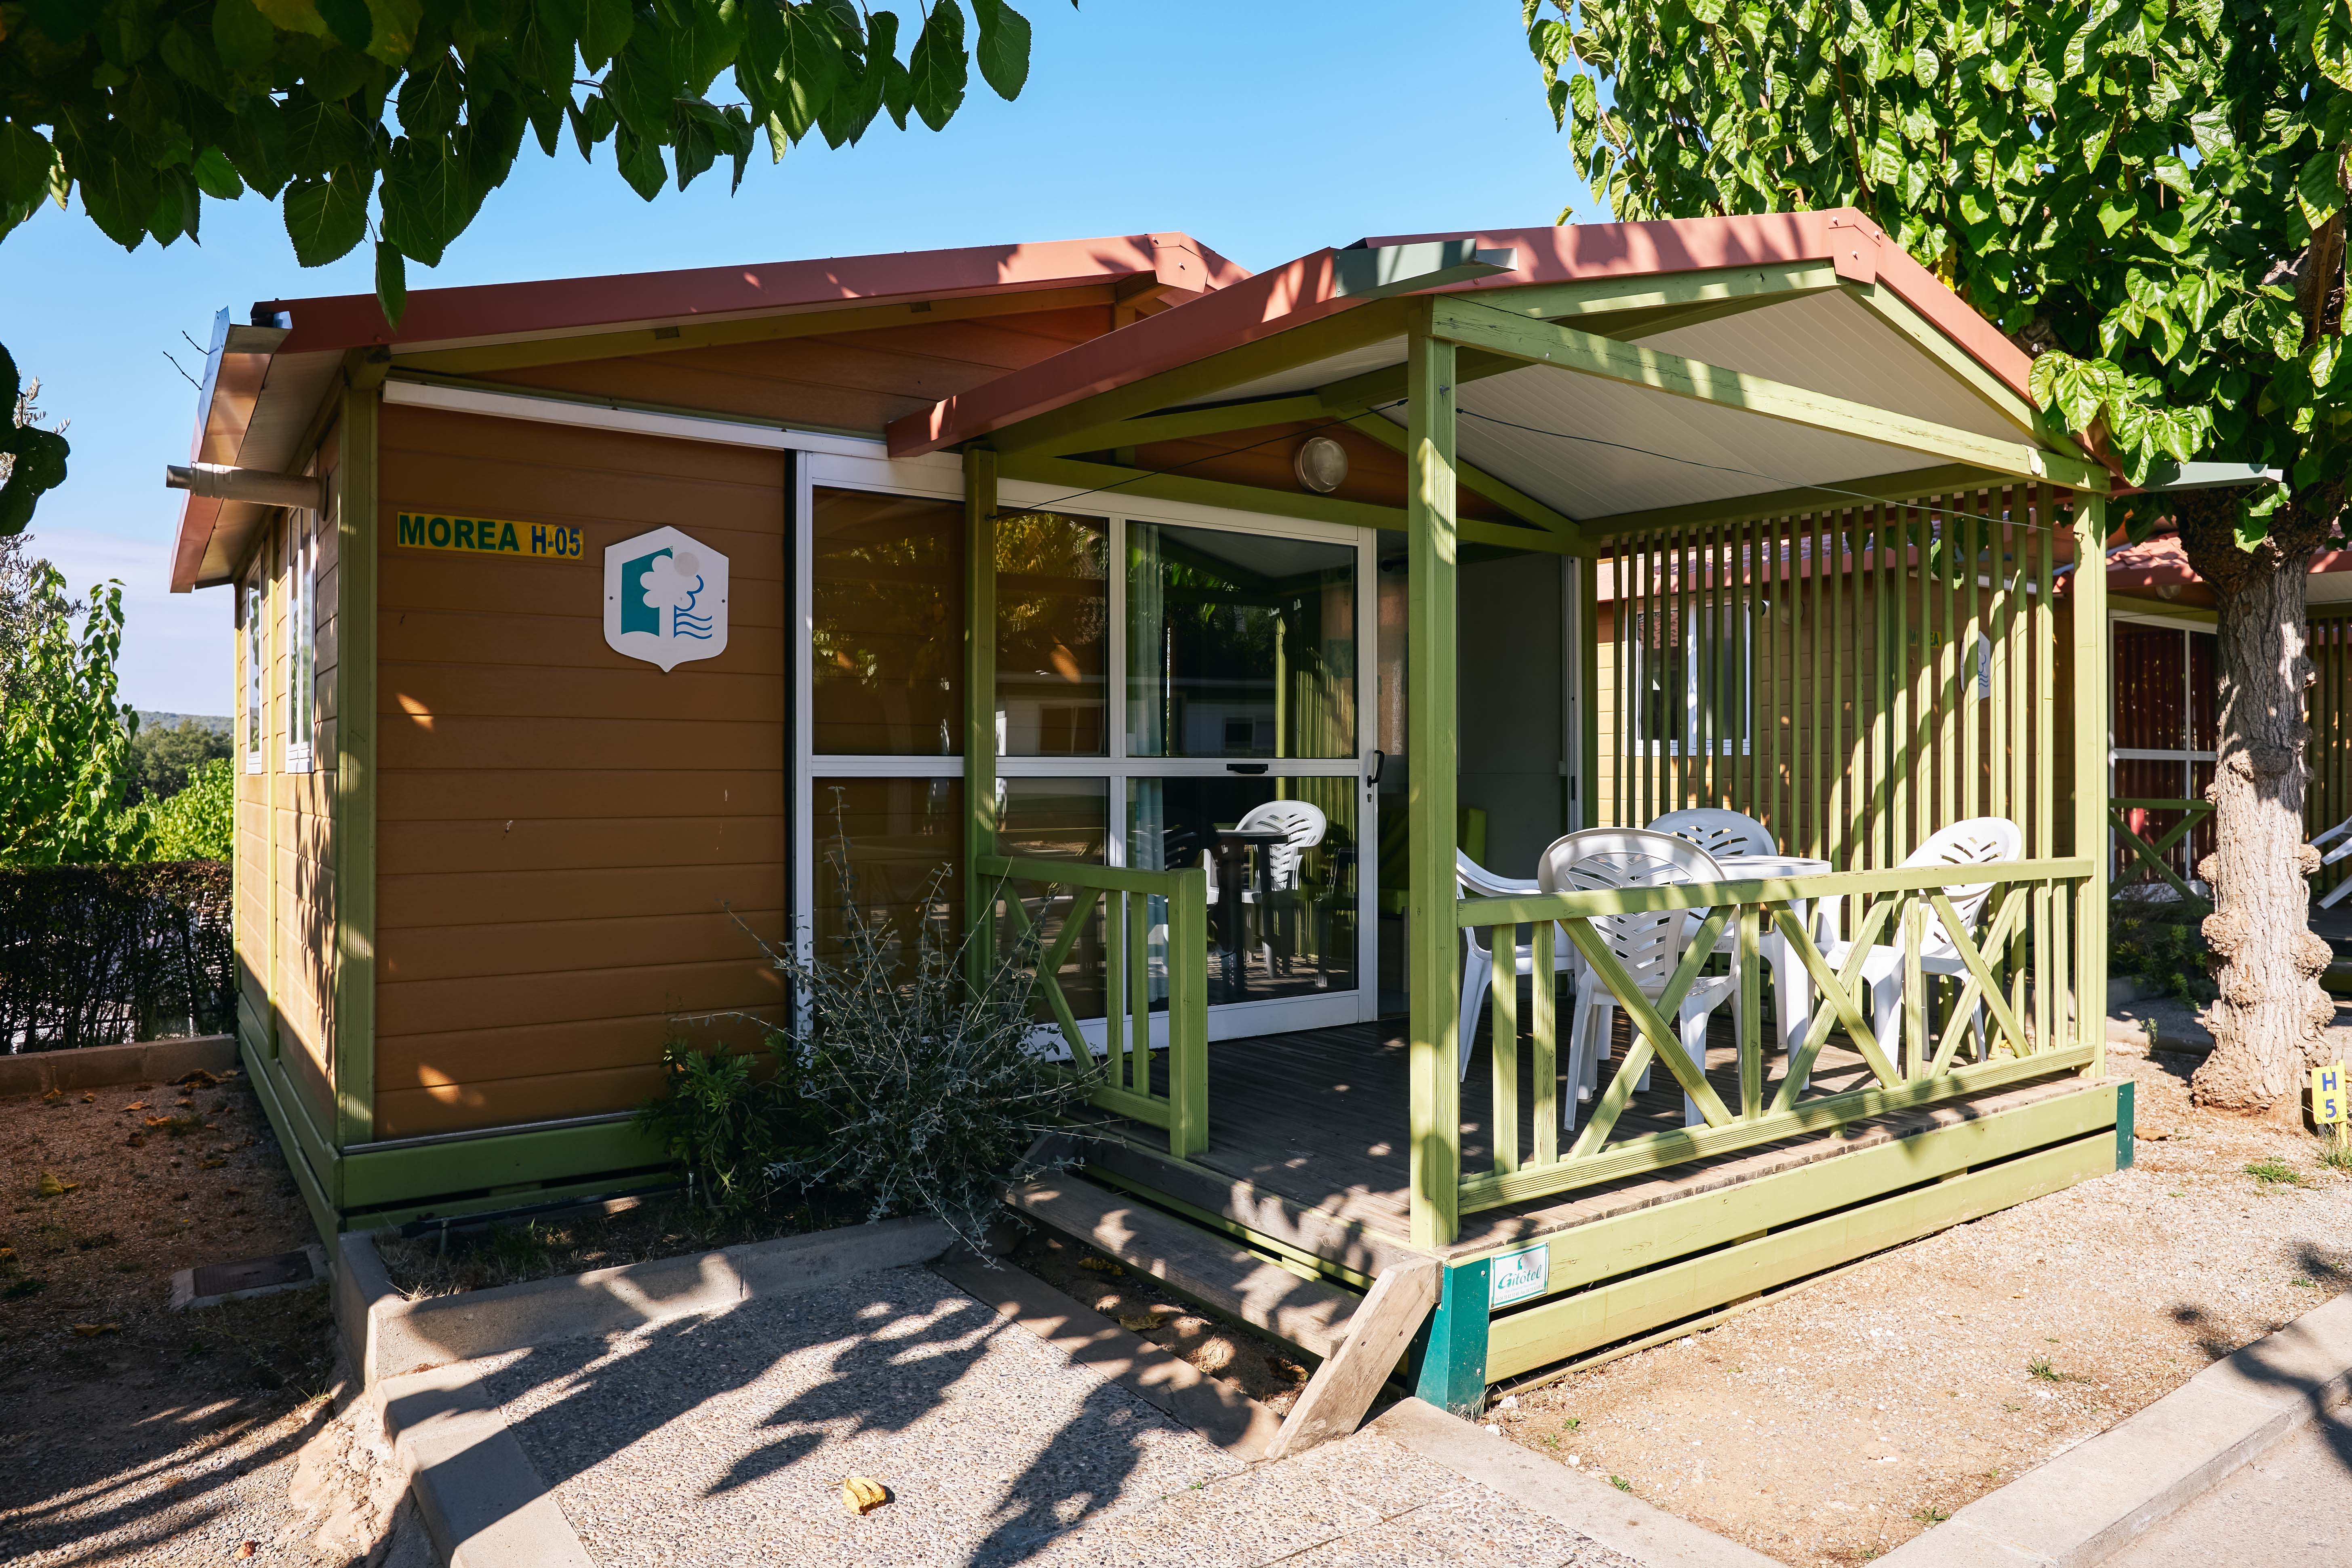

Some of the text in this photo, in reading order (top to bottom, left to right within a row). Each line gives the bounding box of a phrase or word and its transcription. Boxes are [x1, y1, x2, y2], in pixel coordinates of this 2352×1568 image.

[399, 514, 581, 557] MOREA H-05
[1909, 629, 1939, 646] MEA
[2322, 1071, 2337, 1091] H
[2325, 1099, 2337, 1118] 5
